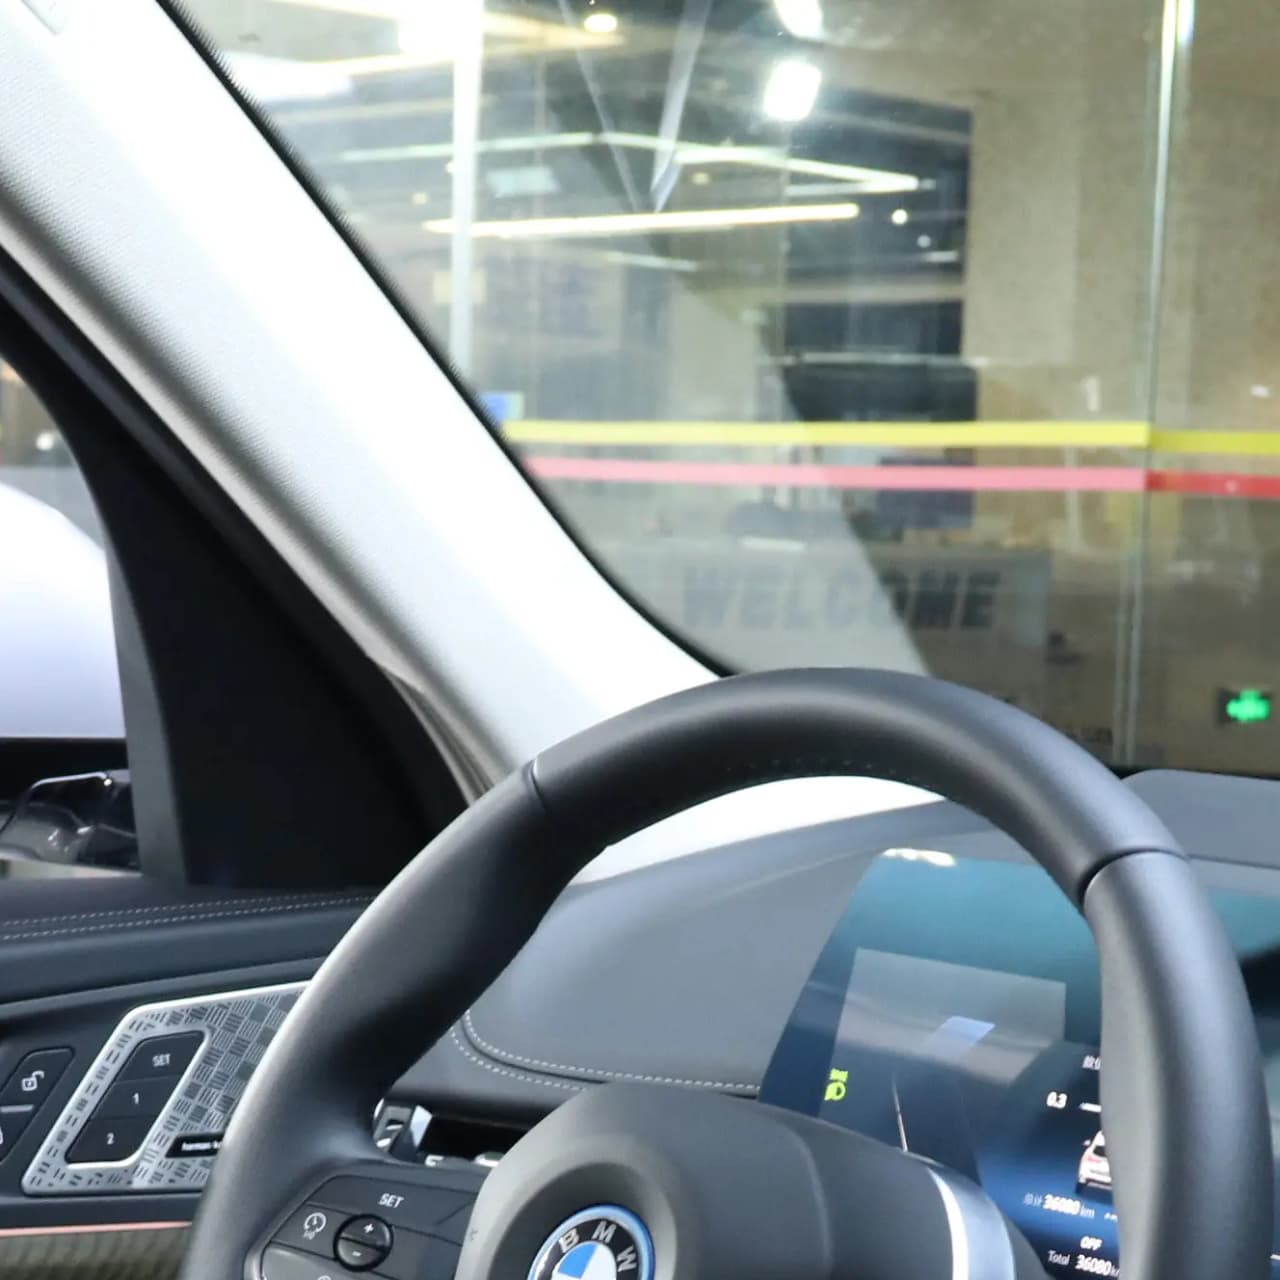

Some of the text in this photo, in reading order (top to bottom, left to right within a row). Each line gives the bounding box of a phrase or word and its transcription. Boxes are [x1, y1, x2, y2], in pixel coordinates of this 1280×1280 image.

[152, 1053, 170, 1067] SET
[133, 1093, 139, 1104] 1
[107, 1133, 114, 1144] 2
[379, 1193, 404, 1208] SET
[558, 1220, 637, 1273] BMW
[1048, 1250, 1071, 1266] Total
